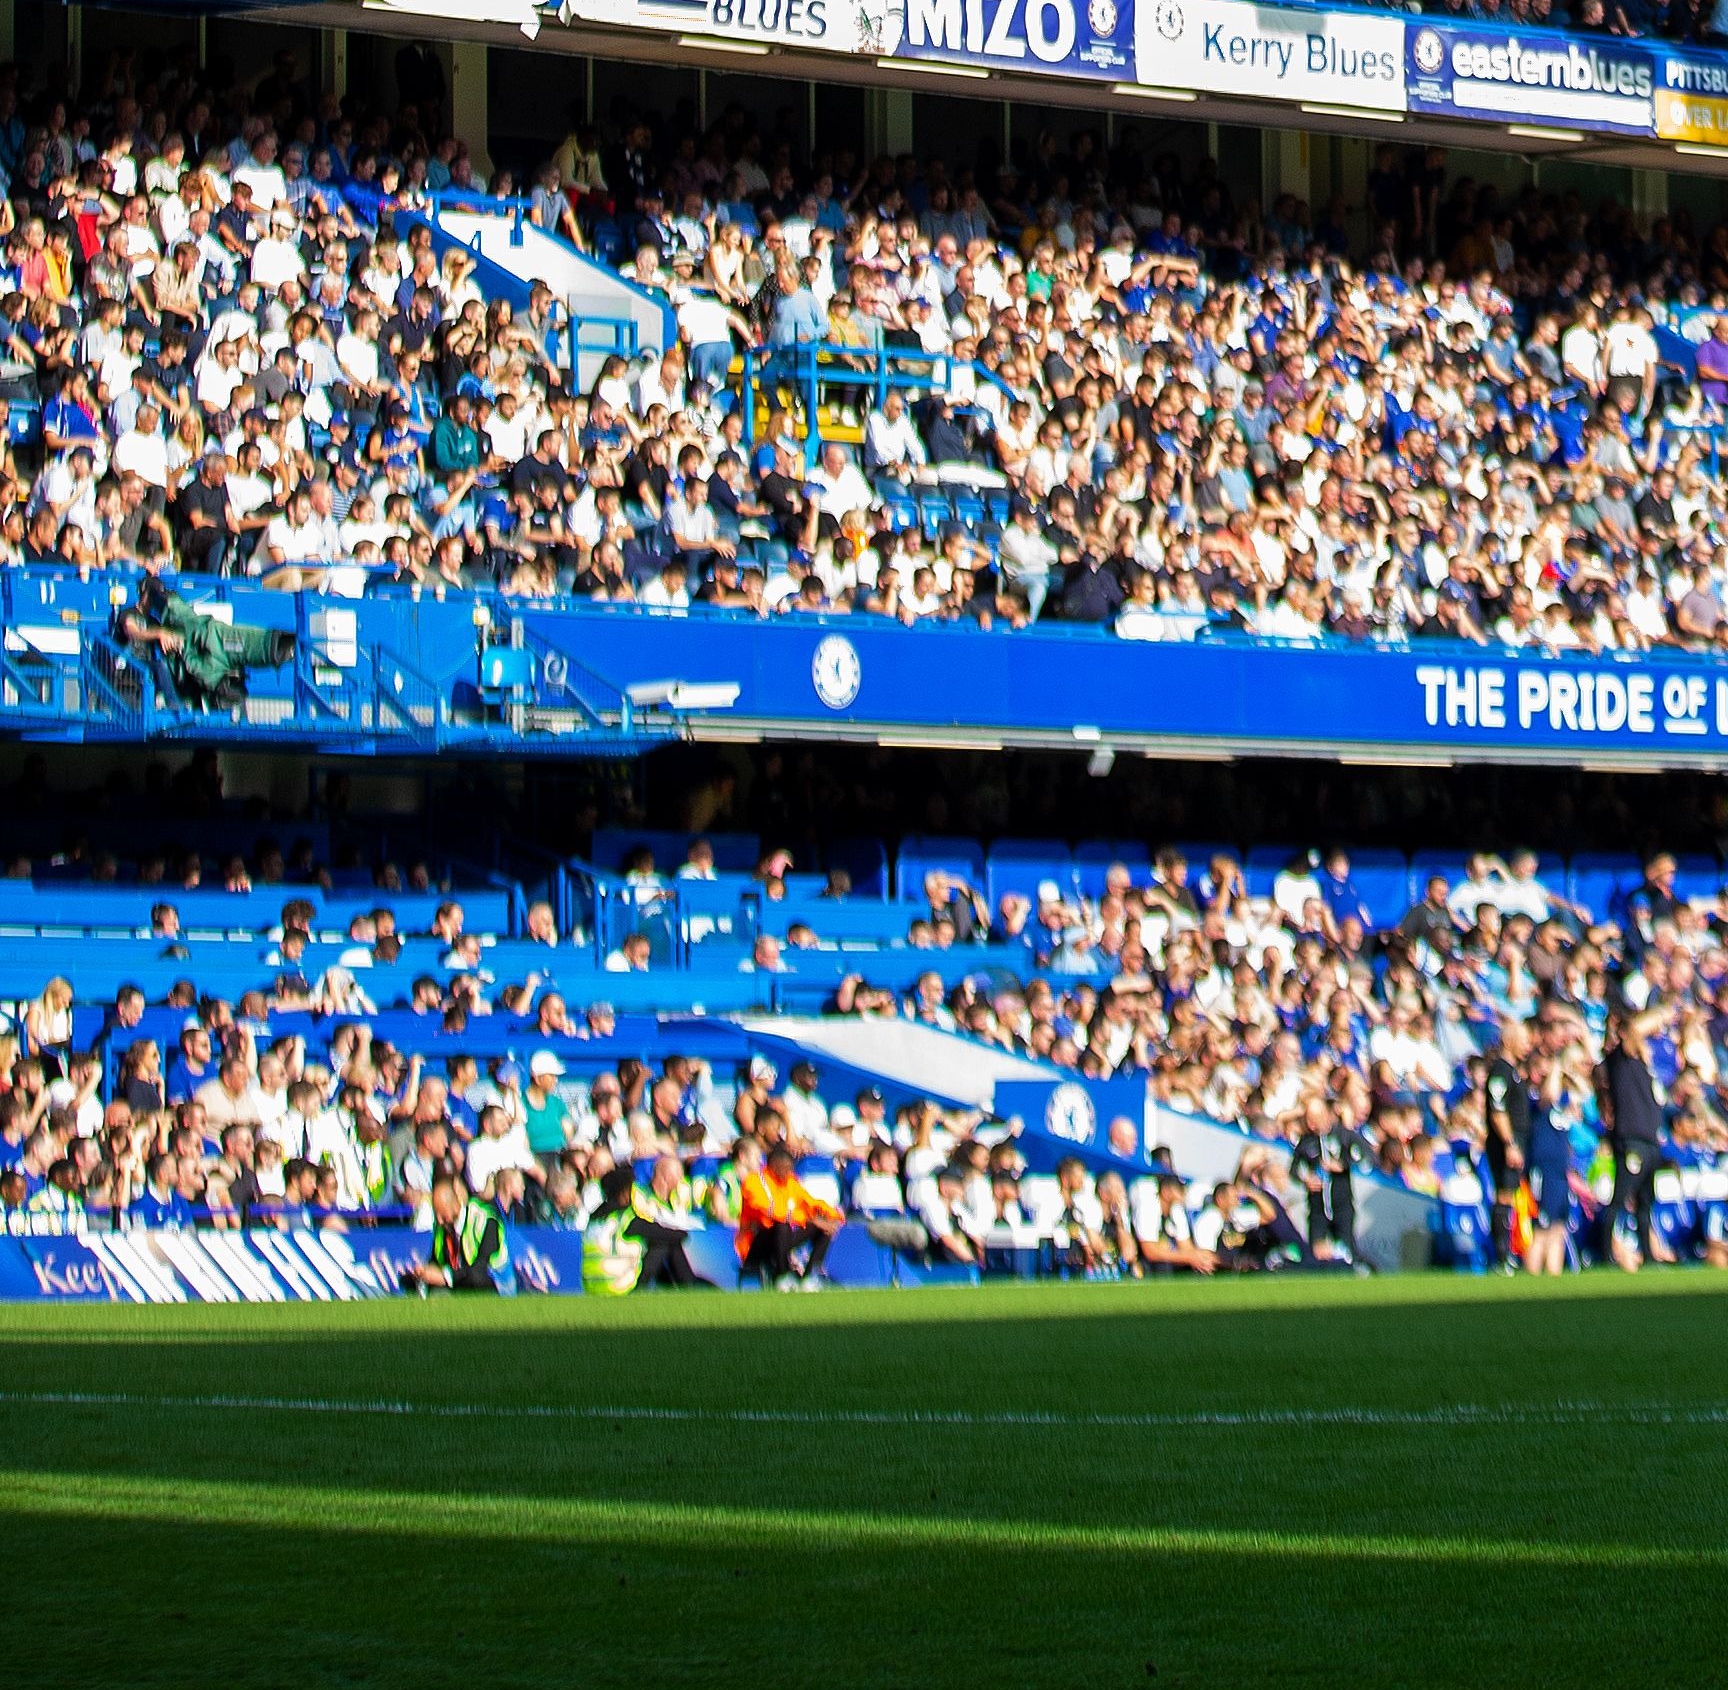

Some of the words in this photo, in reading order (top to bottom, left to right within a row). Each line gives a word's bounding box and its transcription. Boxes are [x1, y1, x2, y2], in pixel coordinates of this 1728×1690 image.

[1203, 22, 1293, 79] Kerry
[1306, 33, 1395, 81] Blues
[1452, 37, 1651, 98] easternblues
[1415, 666, 1506, 729] THE
[1517, 670, 1655, 733] PRIDE
[1662, 674, 1708, 721] OF
